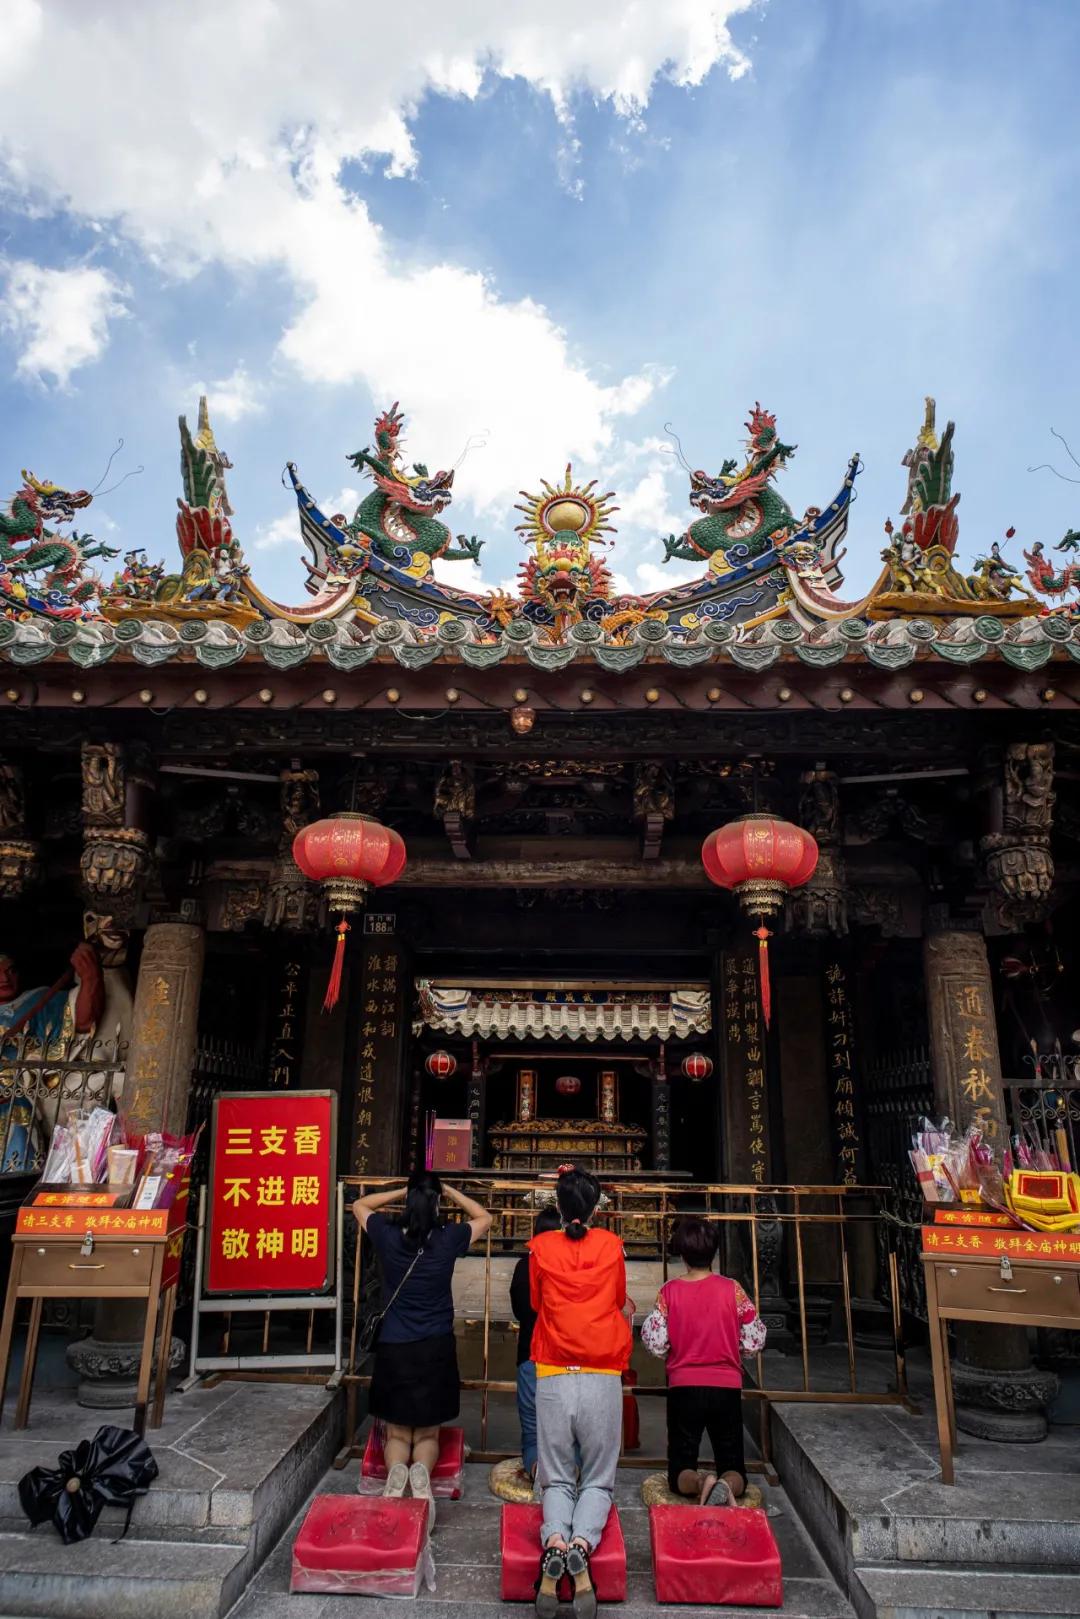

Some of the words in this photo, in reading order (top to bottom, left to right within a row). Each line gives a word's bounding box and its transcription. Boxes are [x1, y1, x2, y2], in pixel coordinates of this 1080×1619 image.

[225, 1125, 321, 1155] 三支香
[223, 1176, 320, 1207] 不进殿
[23, 1214, 76, 1228] 请三支香
[222, 1228, 319, 1259] 敬神明
[926, 1232, 983, 1248] 请三支香
